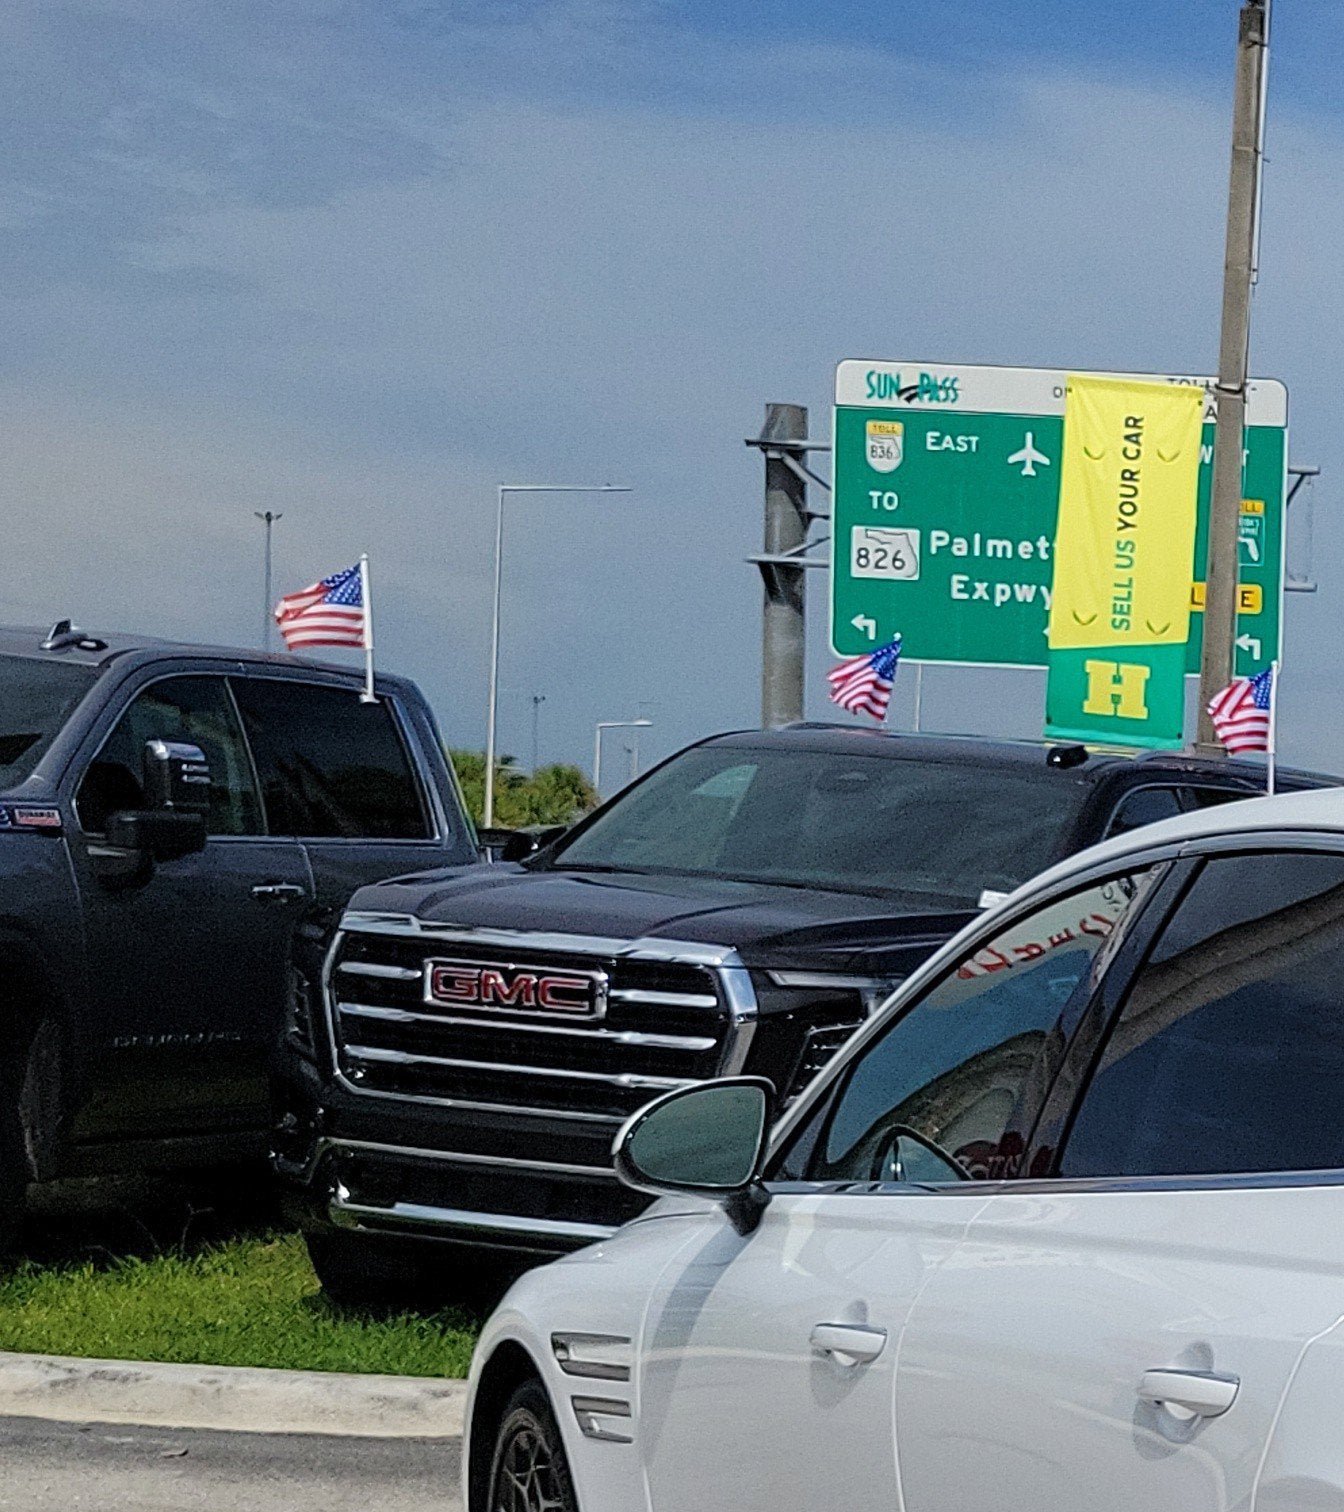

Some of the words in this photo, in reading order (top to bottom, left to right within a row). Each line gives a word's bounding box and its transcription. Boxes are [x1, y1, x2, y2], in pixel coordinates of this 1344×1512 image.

[870, 445, 894, 460] 836
[925, 431, 979, 452] EAST
[1122, 416, 1145, 461] CAR
[868, 490, 899, 511] TO
[1116, 468, 1141, 532] YOUR
[856, 547, 906, 570] 826
[1114, 540, 1136, 569] US
[1111, 577, 1133, 631] SELL
[433, 965, 590, 1012] GMC
